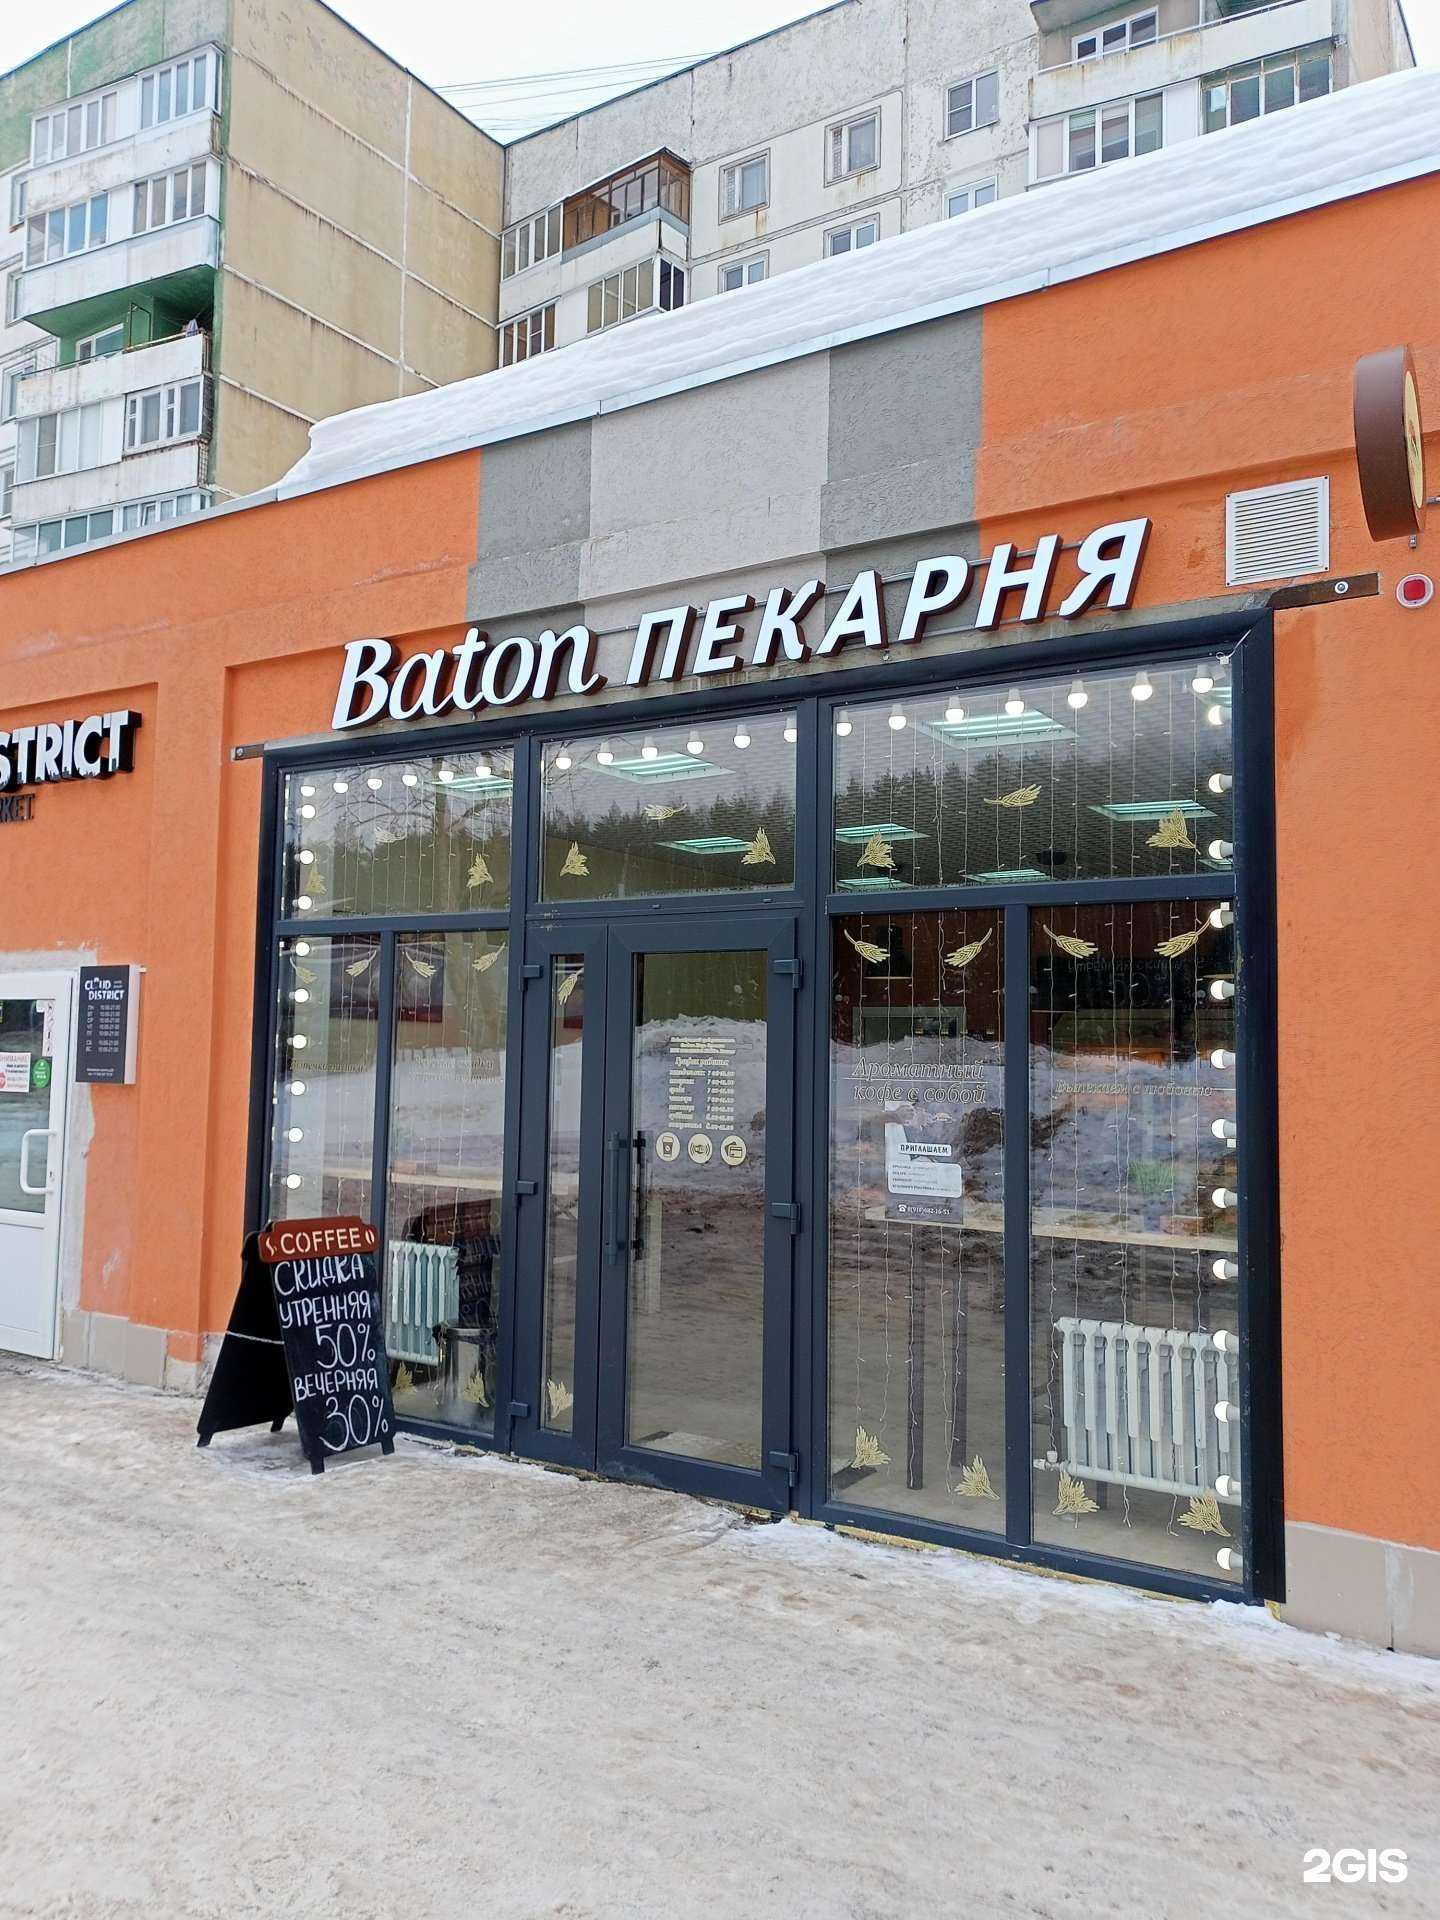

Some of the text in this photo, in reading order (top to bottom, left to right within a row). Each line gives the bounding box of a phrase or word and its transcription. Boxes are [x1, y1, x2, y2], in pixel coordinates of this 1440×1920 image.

[332, 517, 1150, 730] Baton ПЕКАРНЯ
[88, 990, 124, 1001] DISTRICT
[852, 1056, 984, 1080] Ароматный
[854, 1081, 986, 1104] кофе с собой
[900, 1144, 948, 1154] ПРИГЛАШАЕМ
[280, 1227, 362, 1254] COFFEE
[274, 1253, 365, 1296] СКИДКА
[279, 1290, 372, 1329] УТРЕННЯЯ
[316, 1323, 376, 1369] 50%
[293, 1367, 379, 1402] ВЕЧЕРНЯЯ
[318, 1394, 389, 1452] 30%
